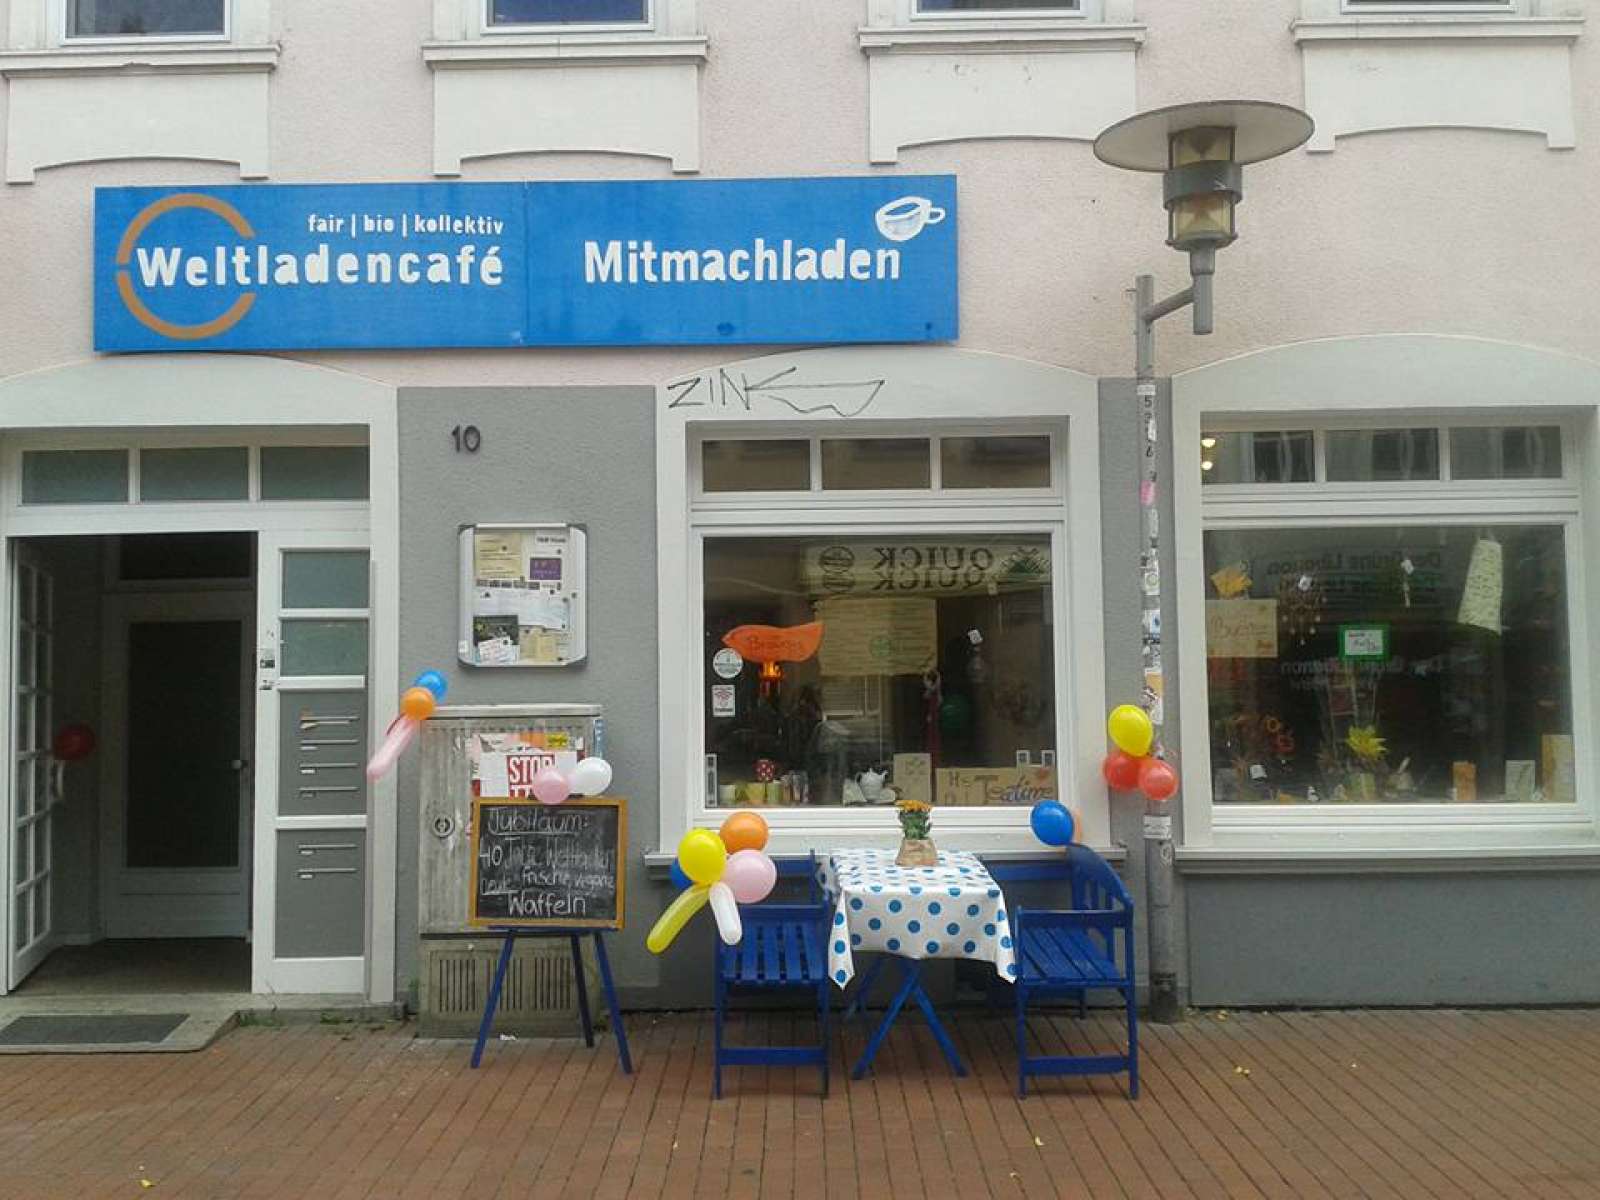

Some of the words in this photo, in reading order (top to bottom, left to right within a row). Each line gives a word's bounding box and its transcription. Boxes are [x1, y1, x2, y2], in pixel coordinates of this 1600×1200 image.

[308, 214, 344, 233] fair
[363, 214, 395, 233] bio
[414, 214, 504, 235] kollektiv
[137, 244, 503, 288] Weltladencafé
[584, 238, 900, 283] Mitmachladen
[451, 424, 481, 453] 10
[507, 885, 586, 917] Waffeln
